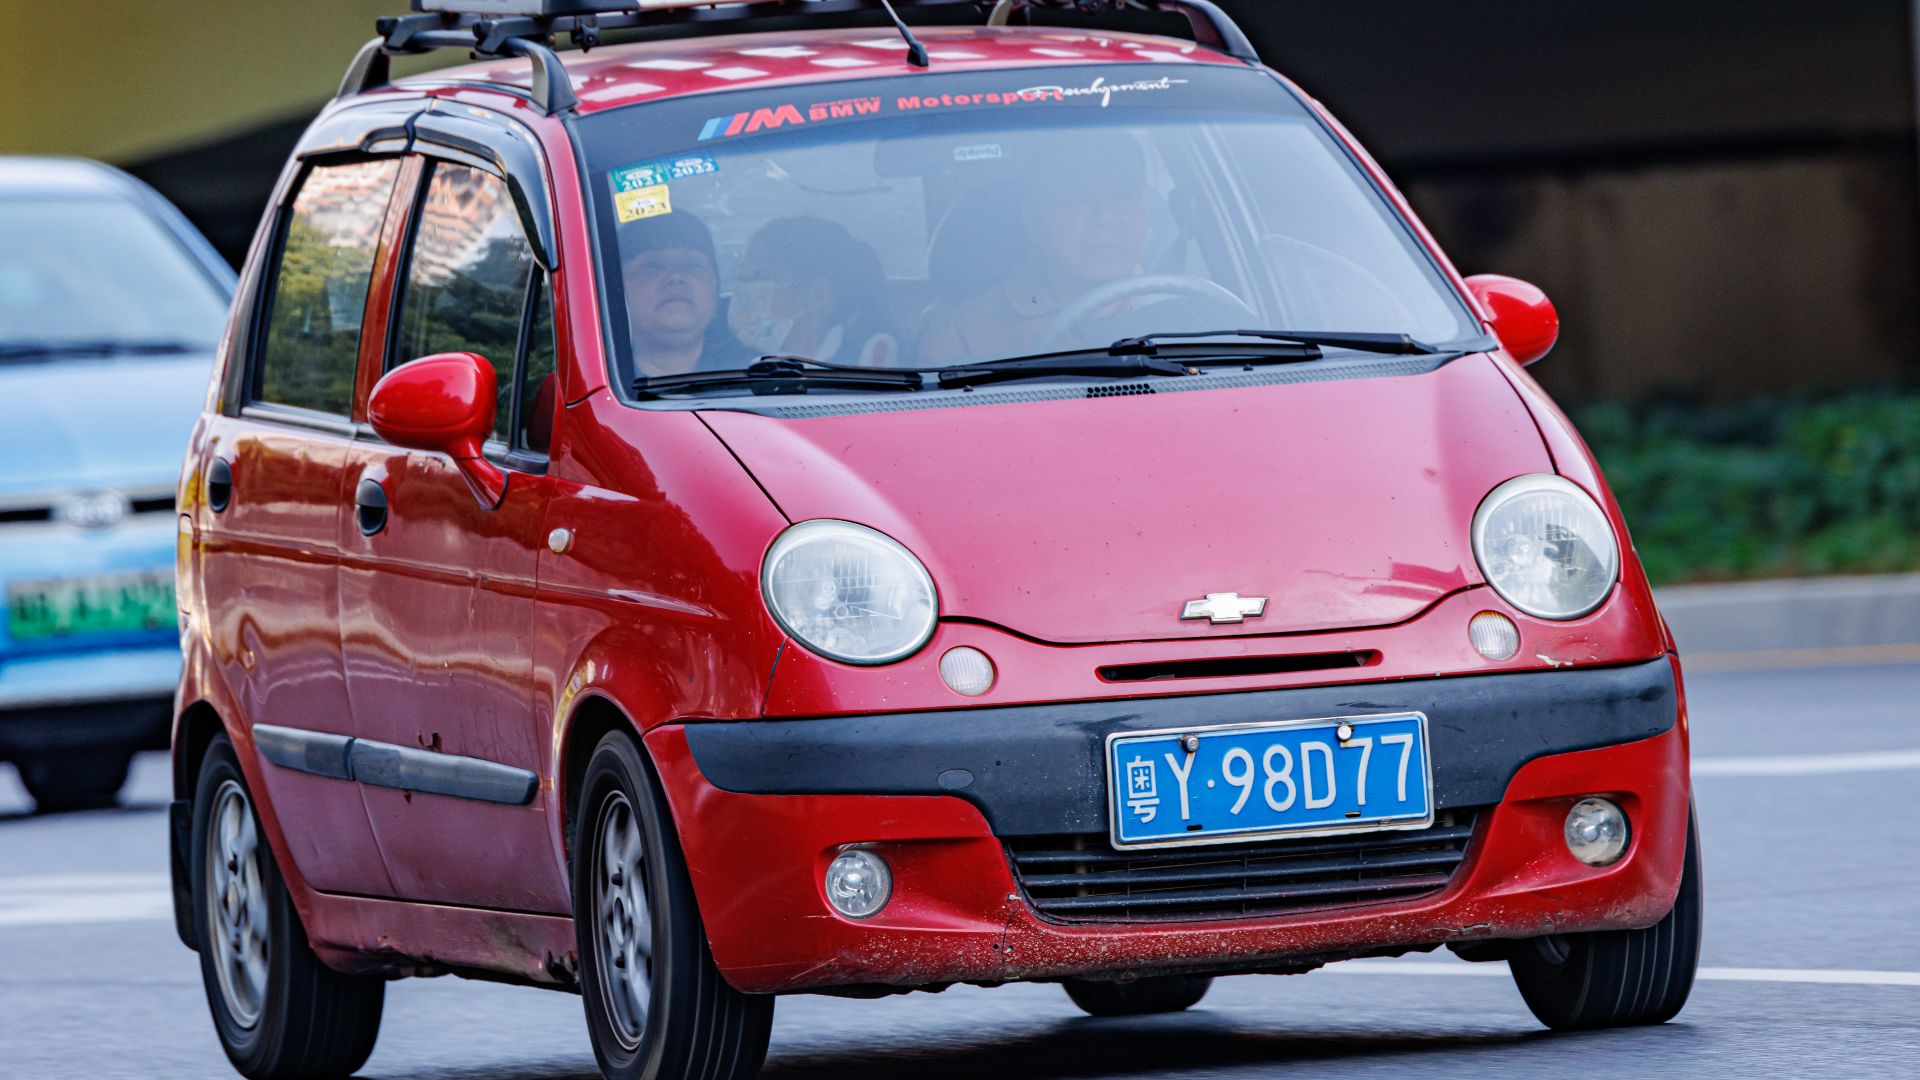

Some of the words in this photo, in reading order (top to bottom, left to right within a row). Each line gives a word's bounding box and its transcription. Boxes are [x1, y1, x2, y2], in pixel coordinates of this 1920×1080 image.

[809, 97, 880, 121] BMW
[897, 89, 1064, 111] Motorsport
[672, 162, 715, 177] 2022
[622, 174, 663, 192] 2021
